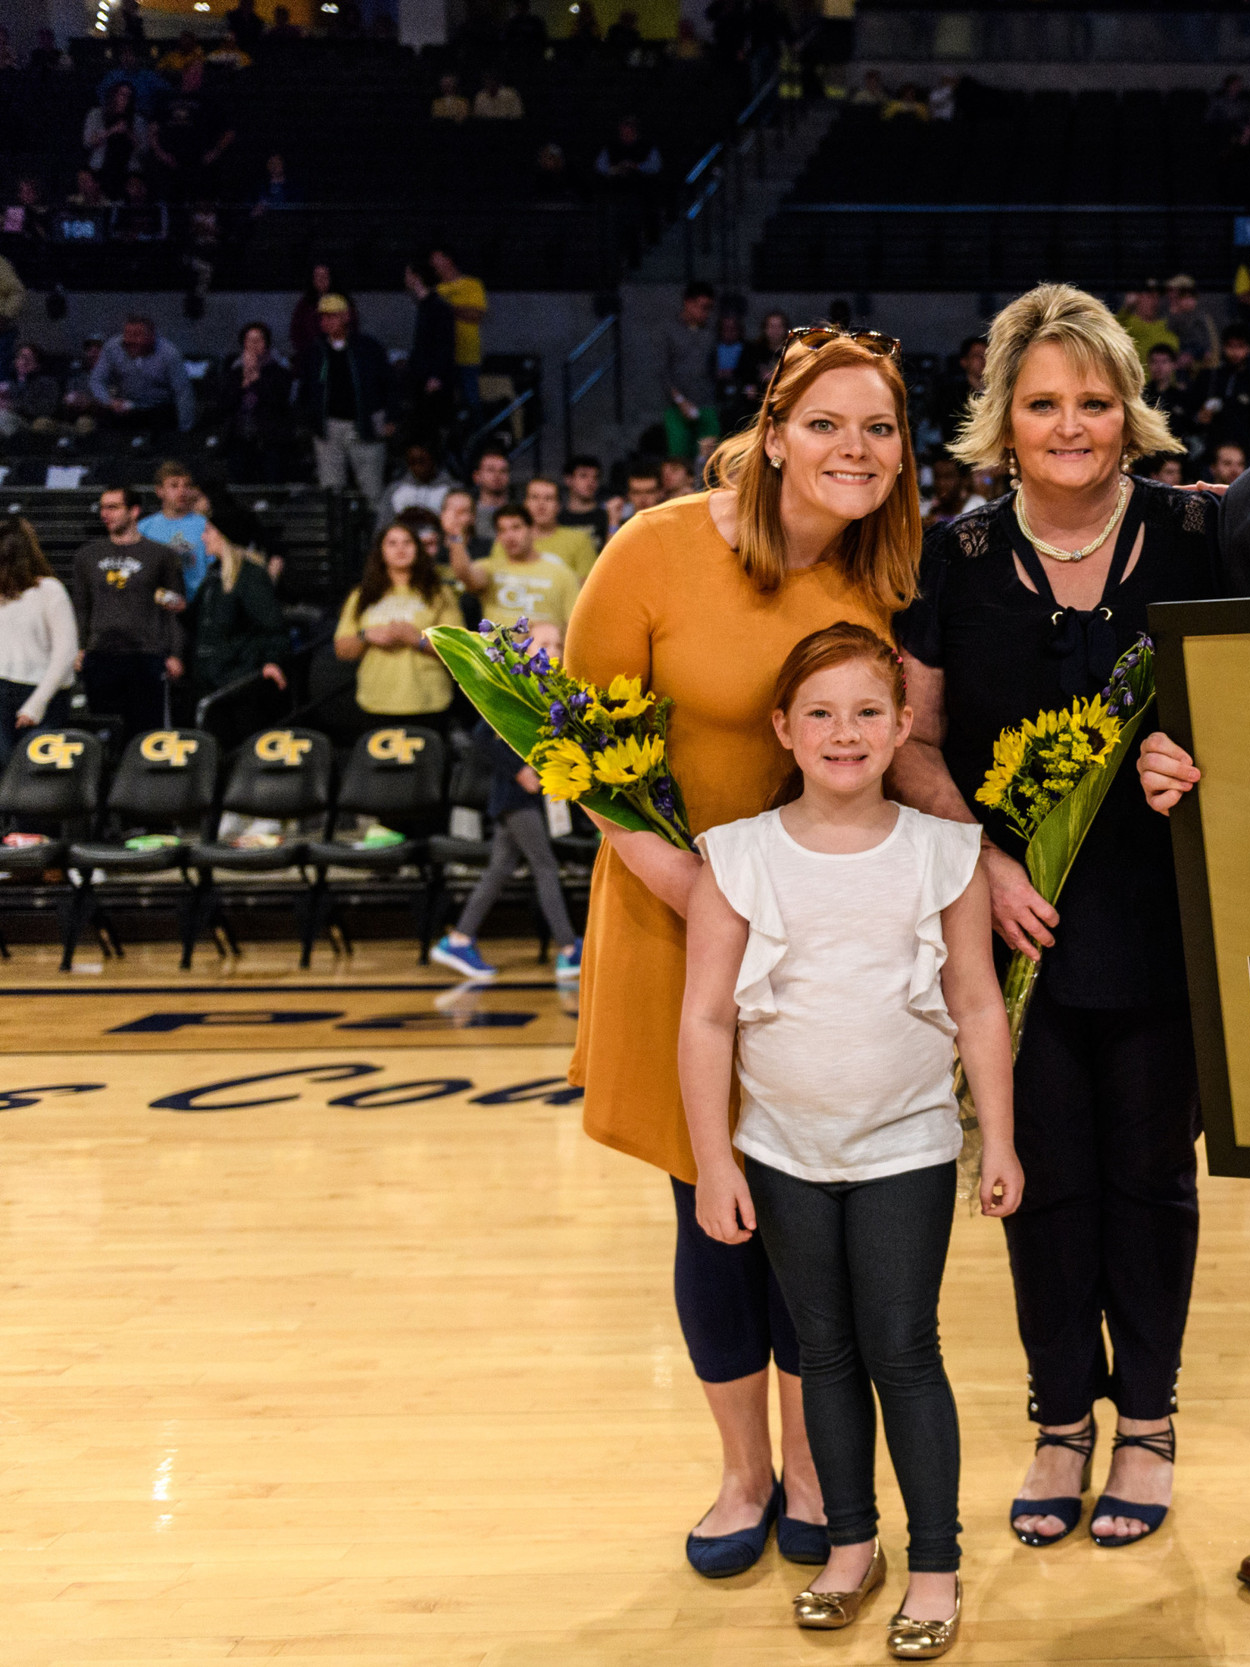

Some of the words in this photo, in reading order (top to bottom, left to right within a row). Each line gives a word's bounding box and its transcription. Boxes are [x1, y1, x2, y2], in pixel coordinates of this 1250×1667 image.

[27, 734, 84, 769] GT
[140, 731, 198, 766] GT
[255, 731, 312, 766] GT
[367, 729, 425, 764] GT
